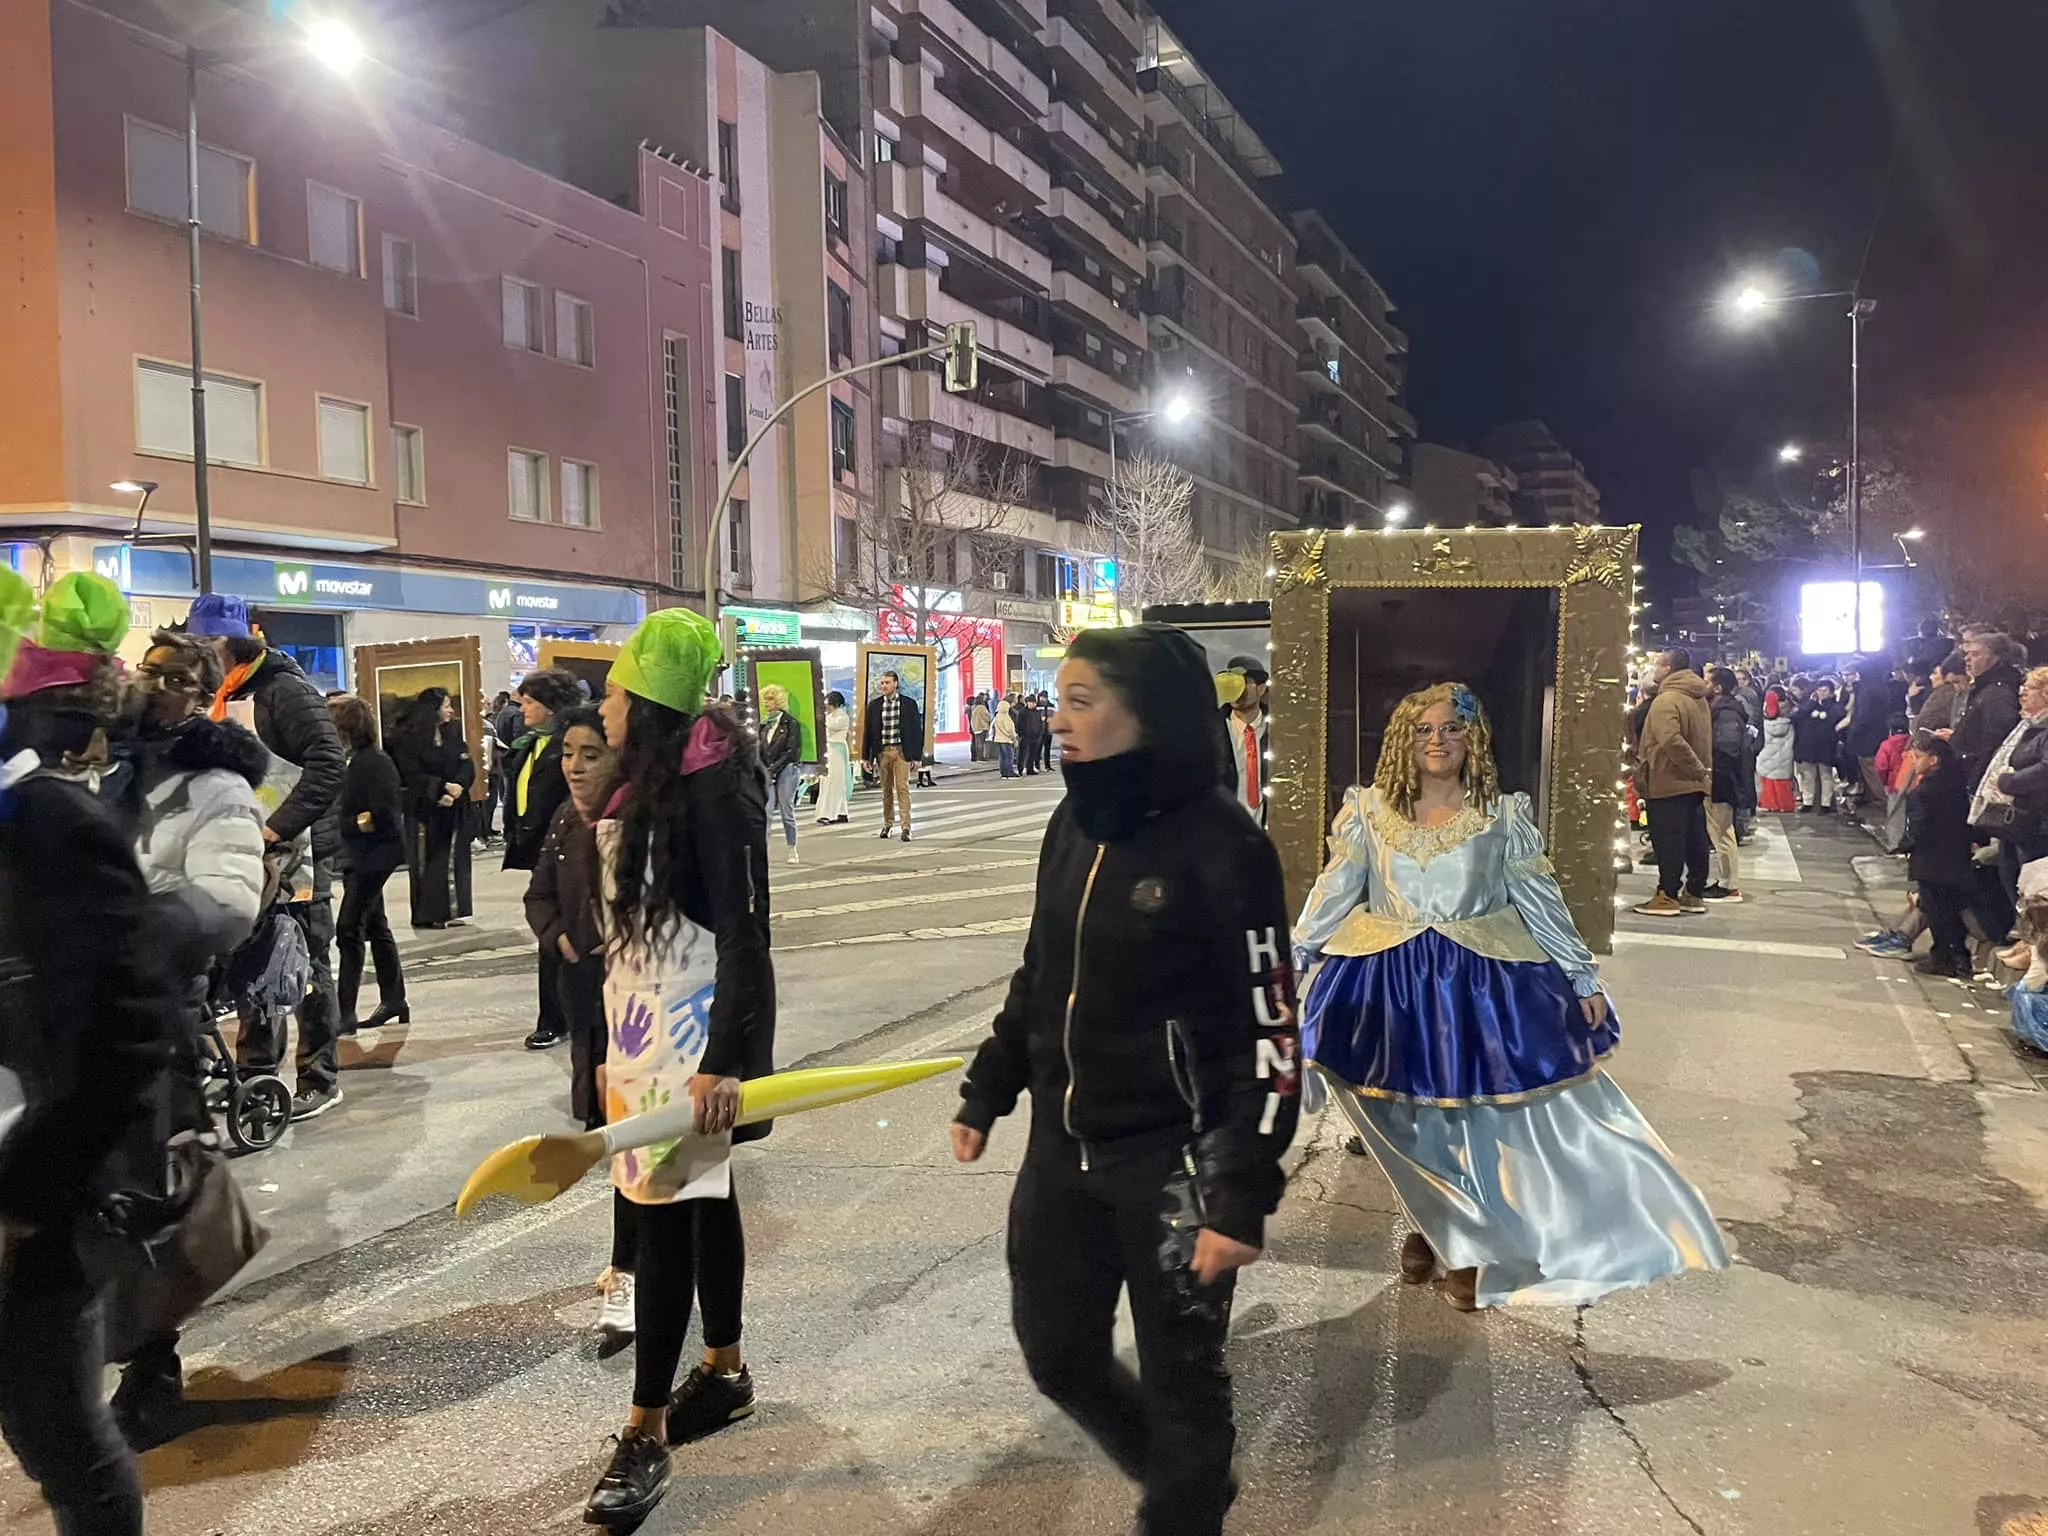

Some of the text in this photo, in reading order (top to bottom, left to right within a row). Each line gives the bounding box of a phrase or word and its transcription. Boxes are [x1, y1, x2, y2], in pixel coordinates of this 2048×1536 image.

[744, 301, 783, 325] BELLAS
[746, 329, 778, 351] ARTES
[316, 578, 373, 597] movistar
[517, 593, 559, 611] movistar
